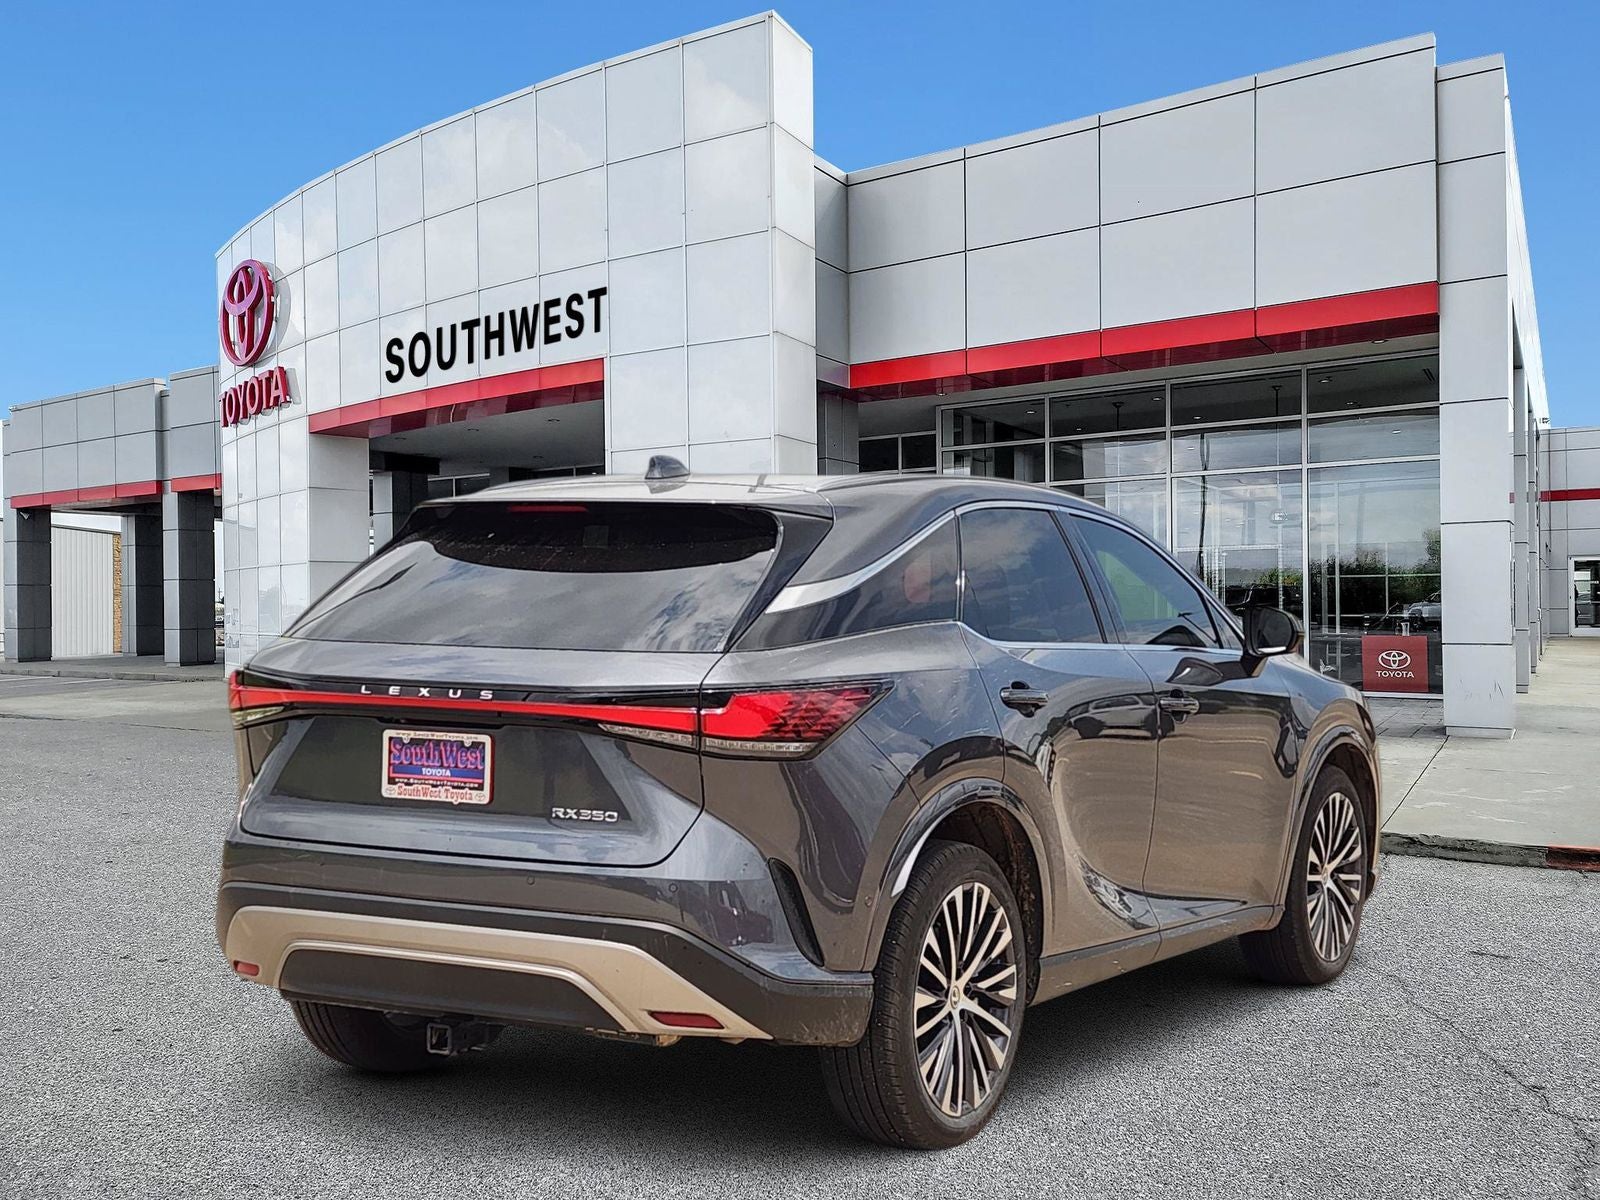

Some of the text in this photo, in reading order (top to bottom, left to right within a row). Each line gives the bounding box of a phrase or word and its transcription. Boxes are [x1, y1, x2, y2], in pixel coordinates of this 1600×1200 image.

[385, 286, 608, 383] SOUTHWEST
[219, 366, 289, 428] TOYOTA
[1376, 670, 1415, 678] TOYOTA
[360, 684, 494, 701] LEXUS
[421, 767, 452, 777] TOYOTA
[444, 788, 473, 802] Toyota
[551, 807, 619, 823] RX350
